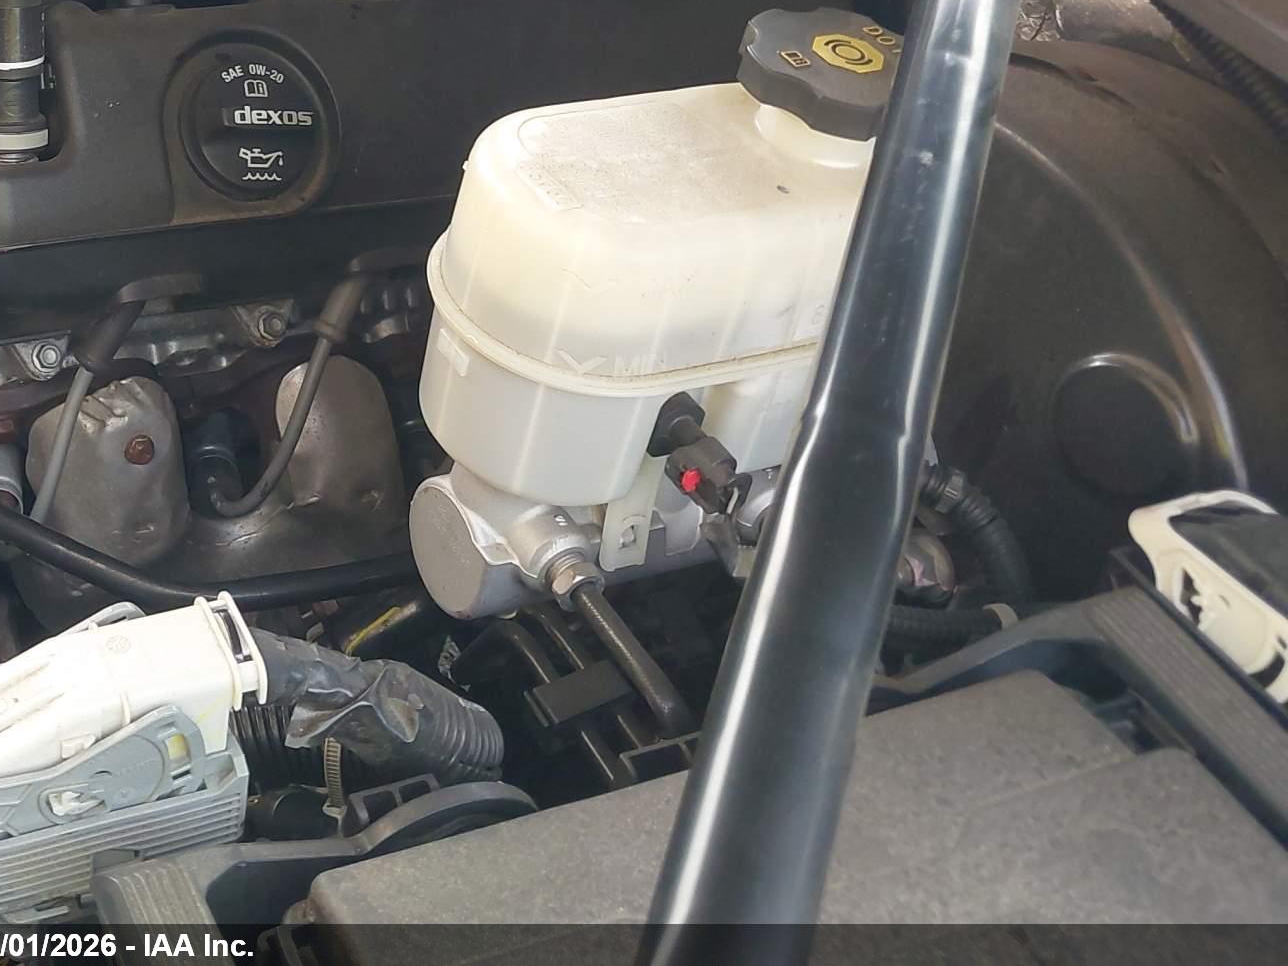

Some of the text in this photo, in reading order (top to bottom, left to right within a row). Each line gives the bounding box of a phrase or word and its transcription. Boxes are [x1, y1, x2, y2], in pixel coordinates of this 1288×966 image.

[221, 64, 284, 84] SAE 0W-20
[234, 105, 314, 126] dexos
